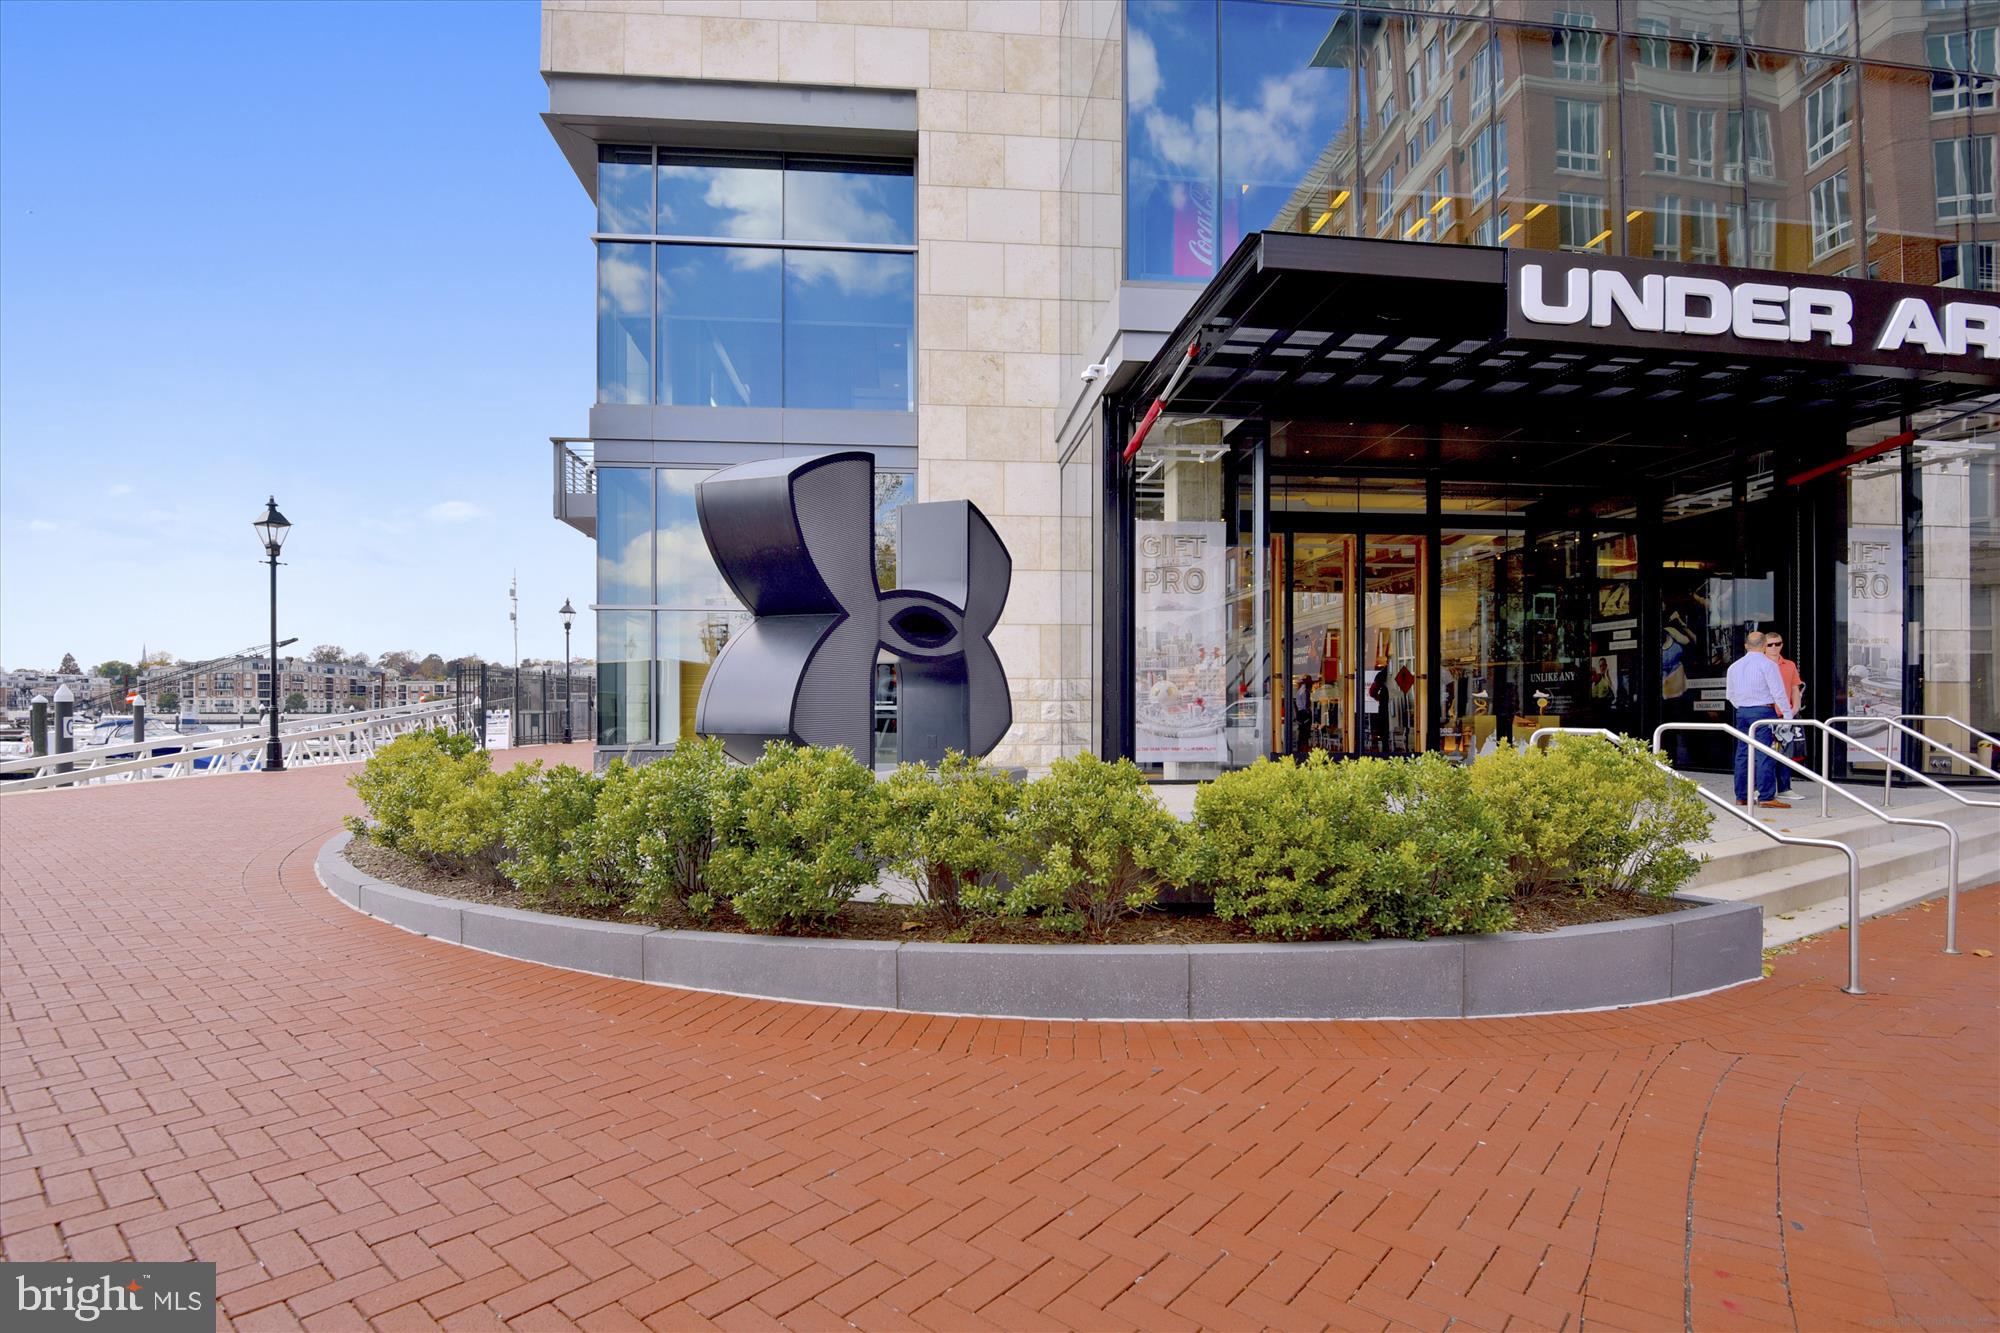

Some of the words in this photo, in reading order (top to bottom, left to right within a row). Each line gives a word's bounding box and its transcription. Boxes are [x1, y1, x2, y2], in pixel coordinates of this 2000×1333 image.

[1520, 264, 1853, 347] UNDER
[1877, 297, 2000, 359] AR
[1140, 534, 1208, 559] GIFT
[1848, 541, 1892, 565] IFT
[1141, 567, 1208, 595] PRO
[1848, 573, 1891, 600] RO
[1530, 672, 1559, 683] UNLIKE
[1559, 671, 1576, 681] ANY
